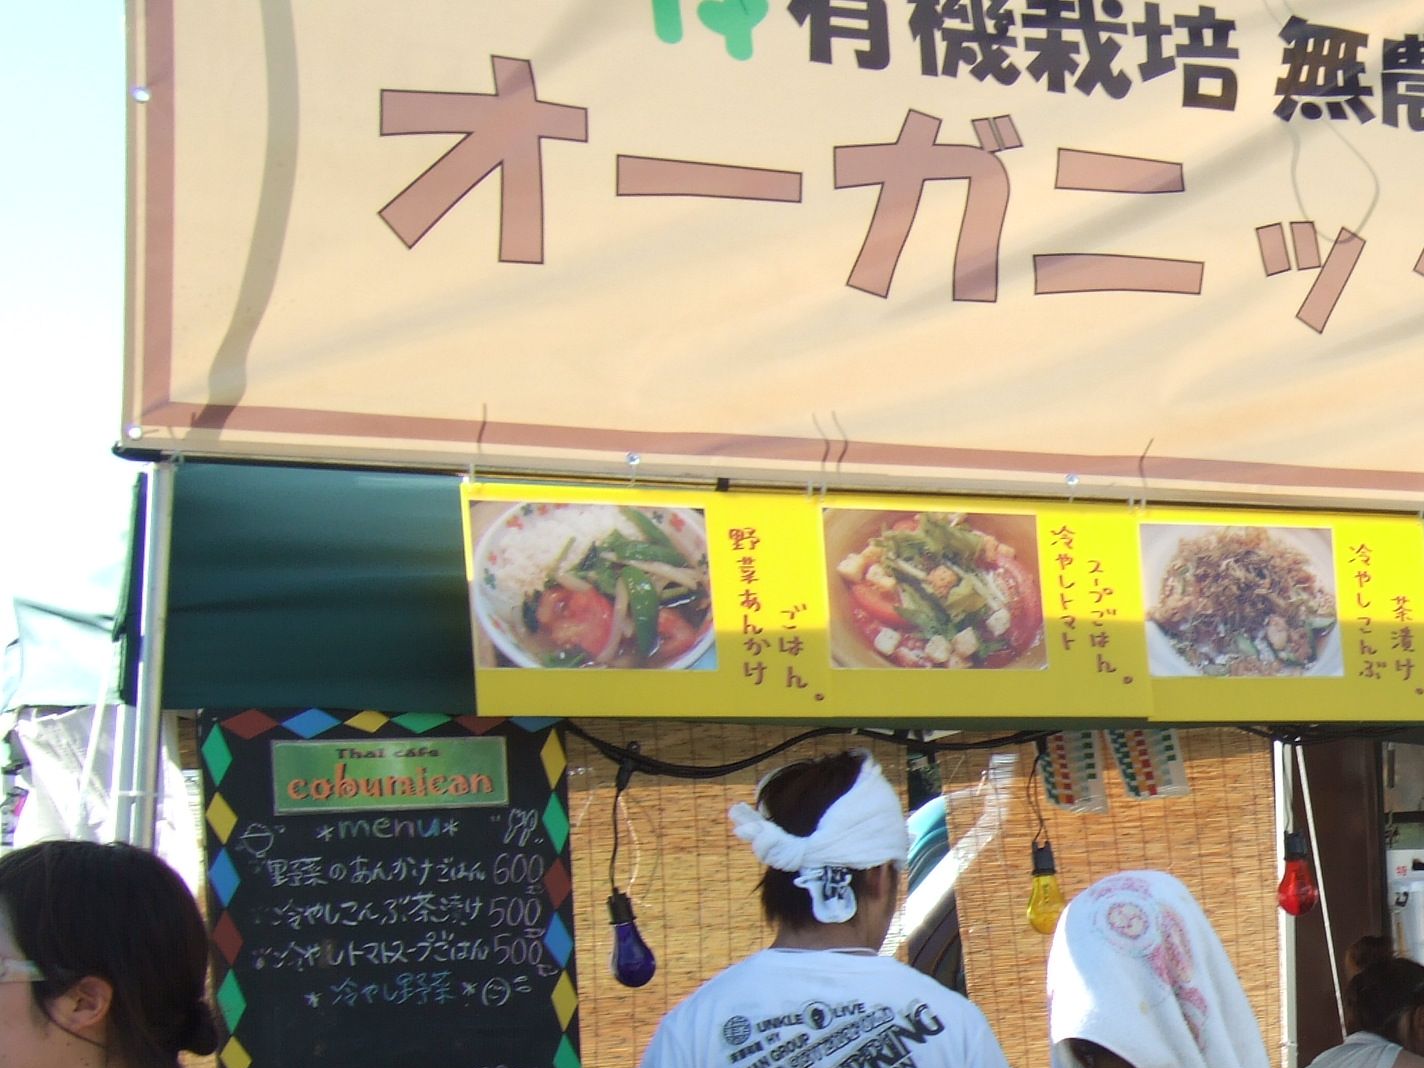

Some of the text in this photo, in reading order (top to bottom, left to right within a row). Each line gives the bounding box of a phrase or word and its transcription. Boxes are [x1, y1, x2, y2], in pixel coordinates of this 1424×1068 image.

[788, 0, 1240, 111] 有機栽培
[1050, 525, 1076, 650] 冷やしトマト
[728, 527, 771, 685] 野菜あんかけ
[1347, 543, 1387, 680] 冷やしこんぶ
[287, 763, 494, 801] cobumican
[493, 853, 545, 885] 600
[488, 896, 541, 927] 500
[494, 933, 544, 965] 500
[756, 1013, 804, 1033] UNKLE
[833, 1002, 866, 1018] LIVE
[769, 1033, 810, 1062] GROUP
